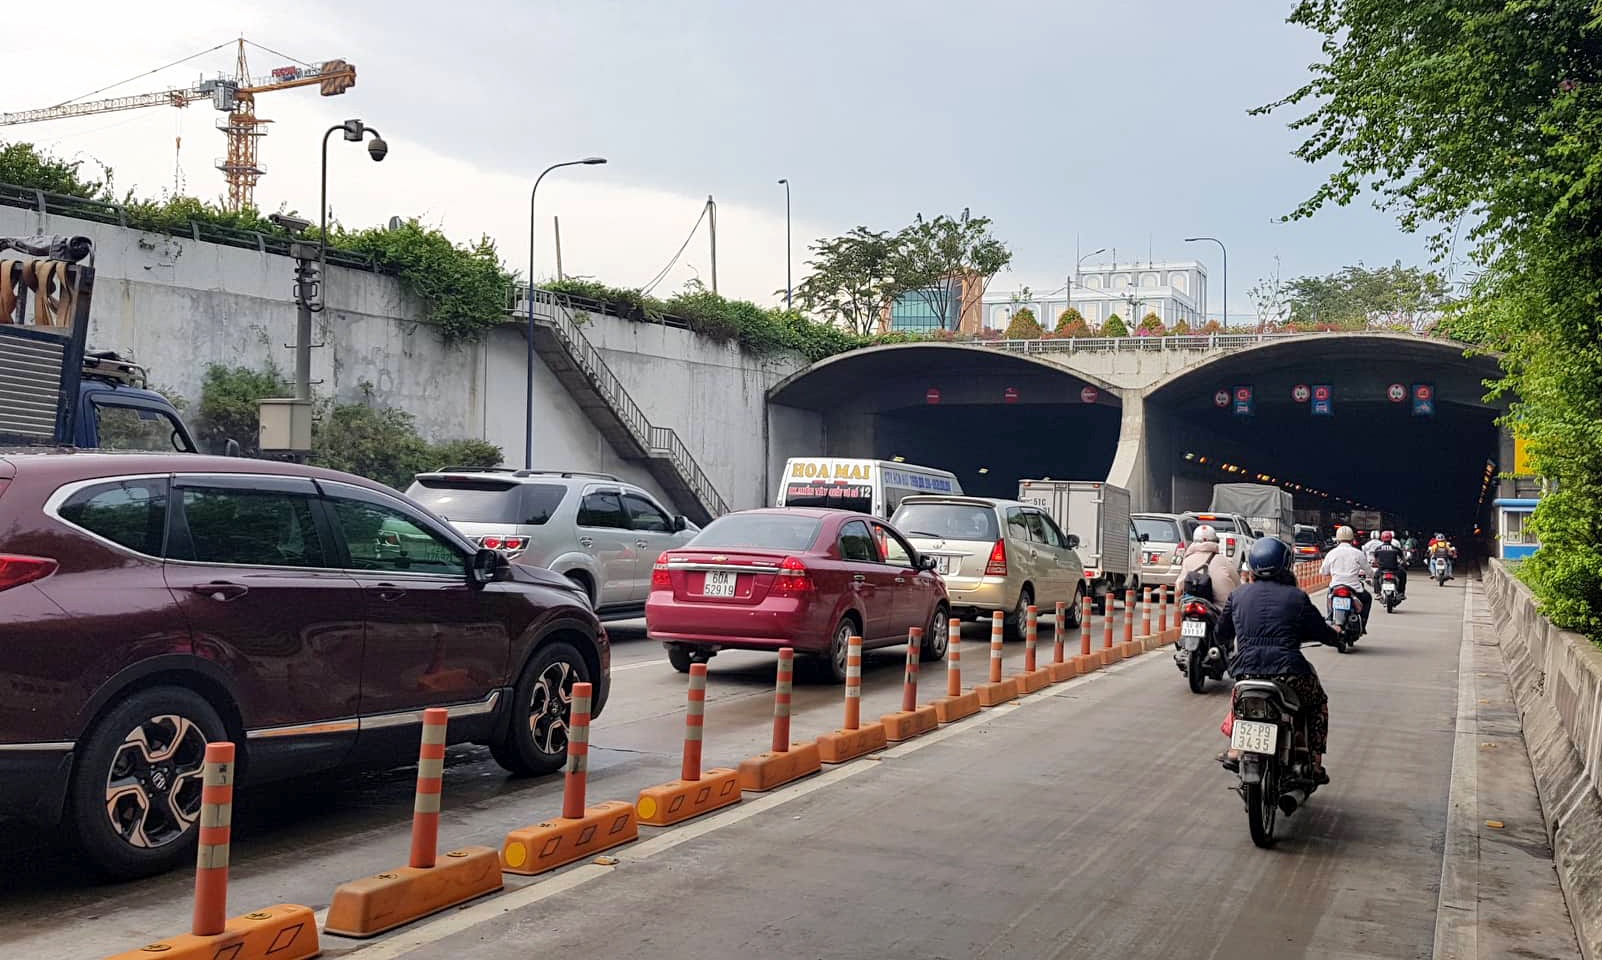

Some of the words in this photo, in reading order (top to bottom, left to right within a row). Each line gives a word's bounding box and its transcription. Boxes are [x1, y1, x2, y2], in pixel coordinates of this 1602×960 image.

[792, 463, 830, 478] HOA
[834, 464, 871, 480] MAI
[860, 486, 871, 498] 12
[1034, 497, 1047, 506] 51C
[713, 573, 728, 584] 60A
[1240, 723, 1270, 738] 52-P9
[1239, 736, 1269, 751] 3435
